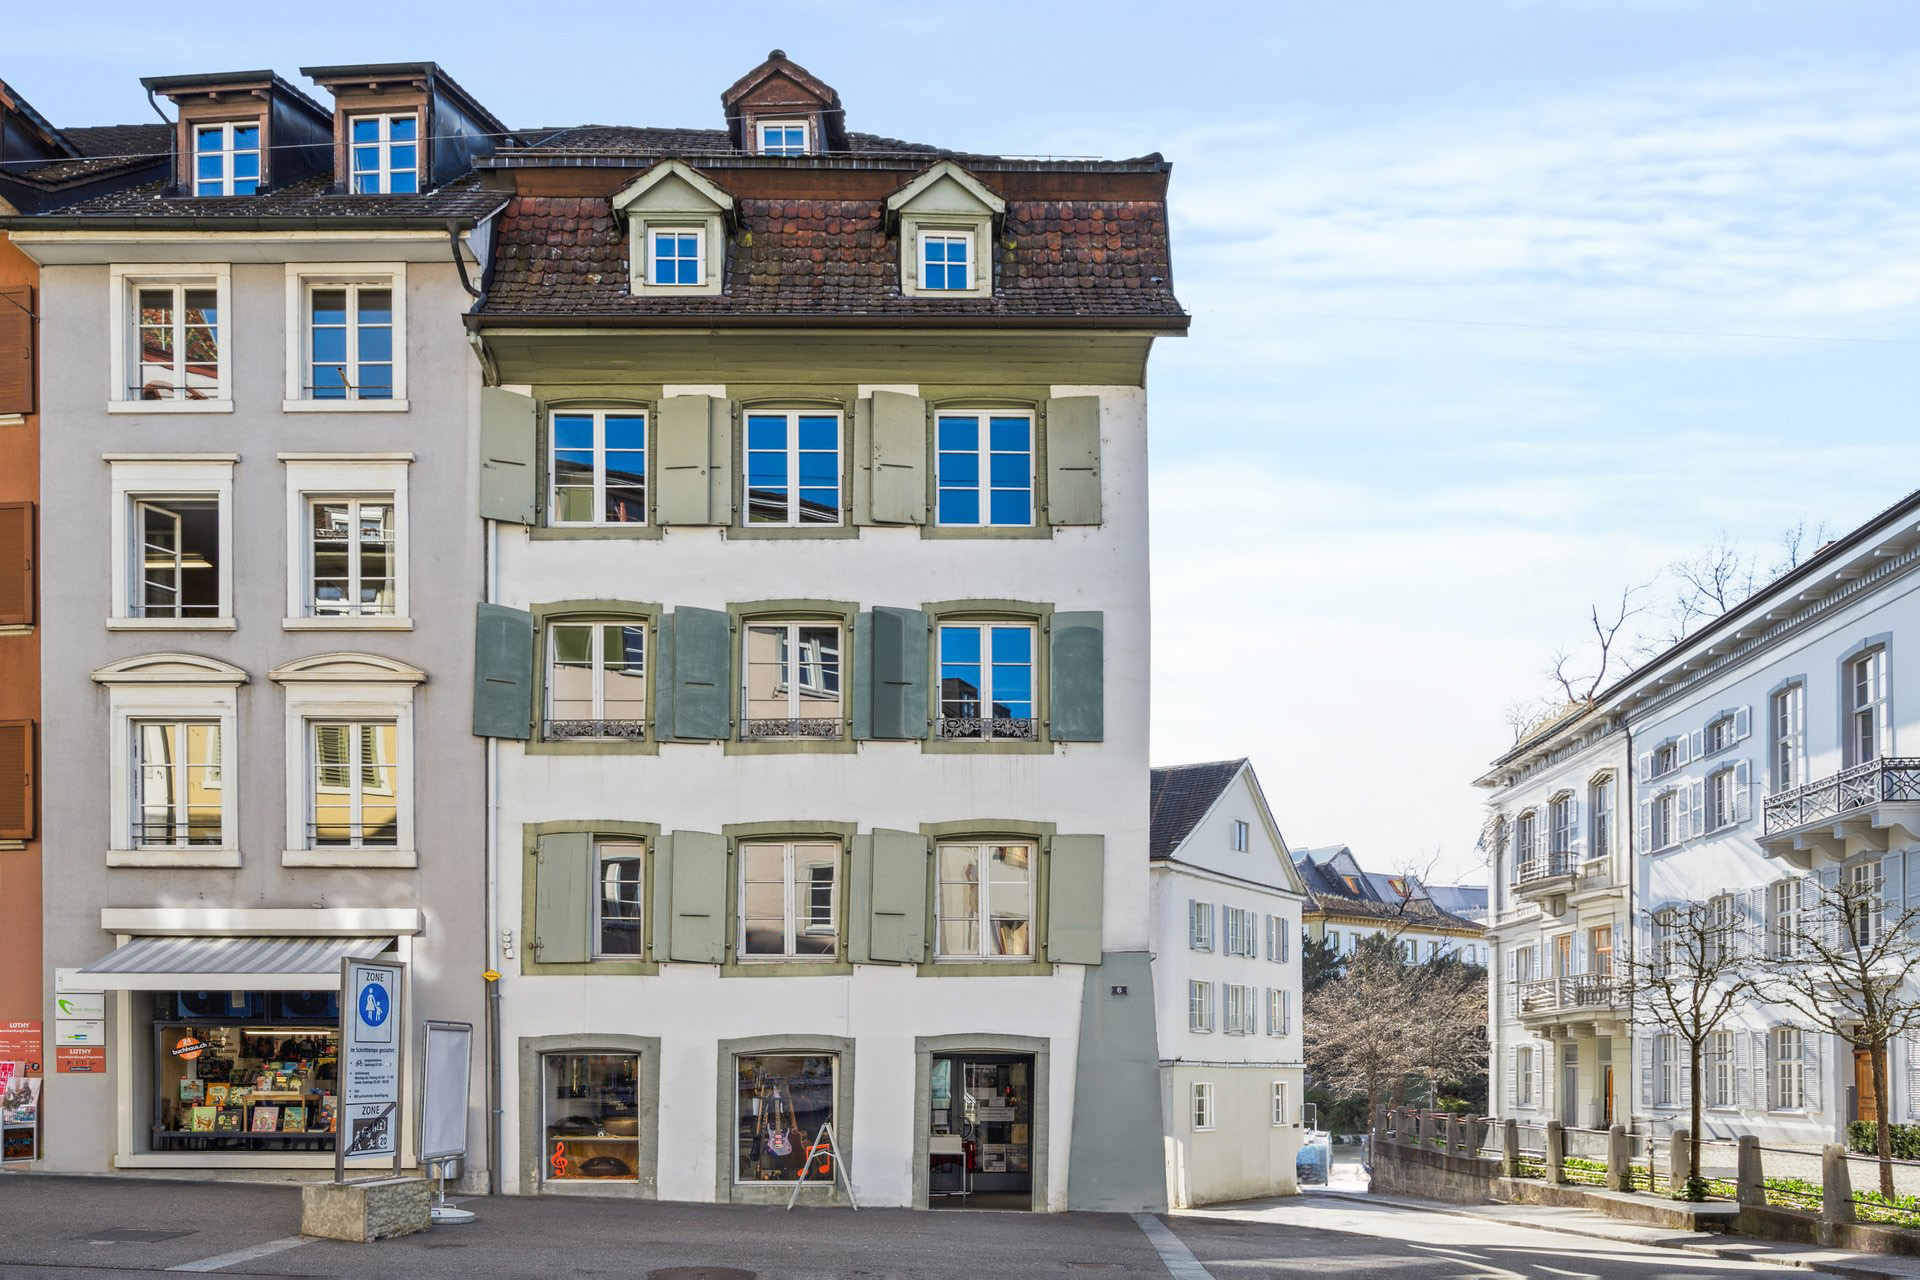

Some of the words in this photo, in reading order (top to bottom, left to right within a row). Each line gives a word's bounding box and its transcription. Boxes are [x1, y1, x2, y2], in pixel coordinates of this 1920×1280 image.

[366, 972, 384, 982] ZONE
[1116, 986, 1122, 994] 6
[171, 1042, 208, 1055] buchhaus.ch
[362, 1106, 380, 1115] ZONE
[380, 1137, 387, 1146] 20
